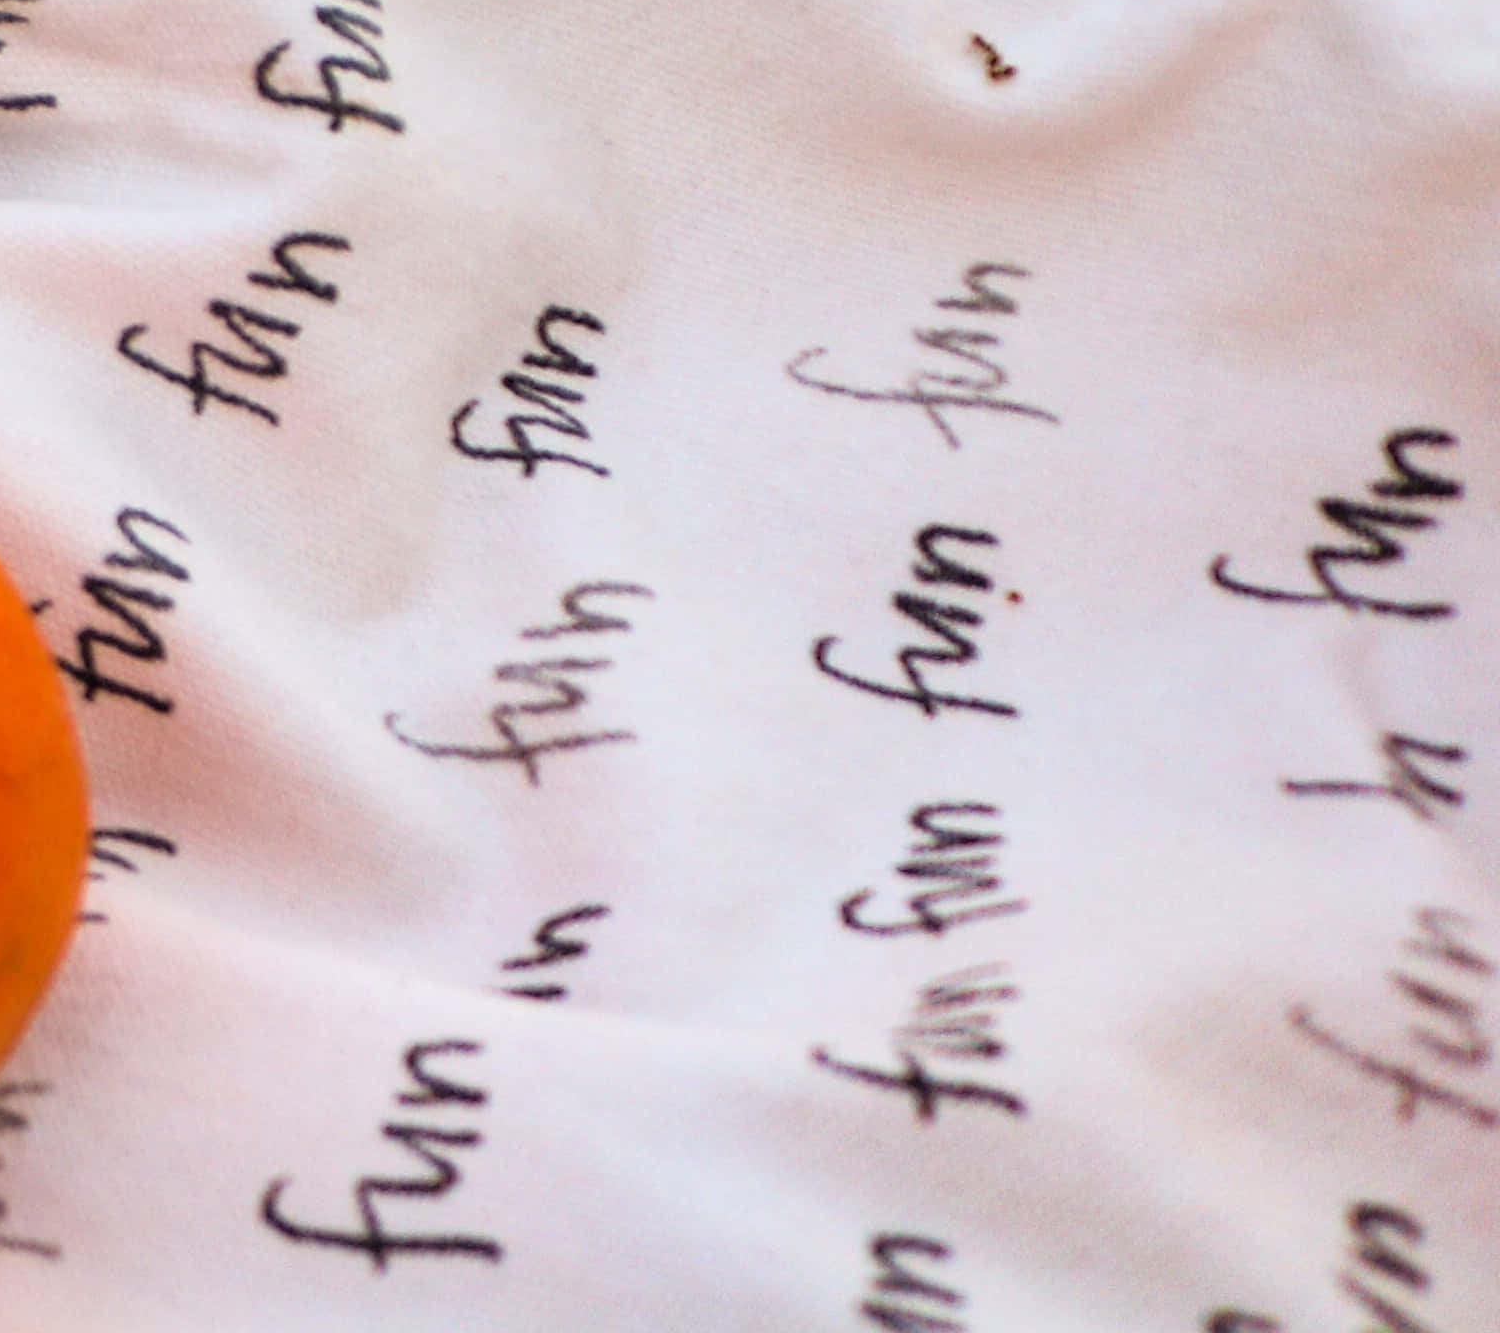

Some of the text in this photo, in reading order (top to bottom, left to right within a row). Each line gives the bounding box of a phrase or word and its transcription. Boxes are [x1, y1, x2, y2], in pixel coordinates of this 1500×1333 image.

[116, 231, 351, 427] fun
[450, 303, 612, 478] fun
[784, 260, 1061, 451] fun
[1208, 427, 1464, 619] fun
[384, 580, 656, 788] fun
[811, 523, 1021, 718] fun
[840, 801, 1030, 937] fun
[259, 1039, 504, 1274] fun
